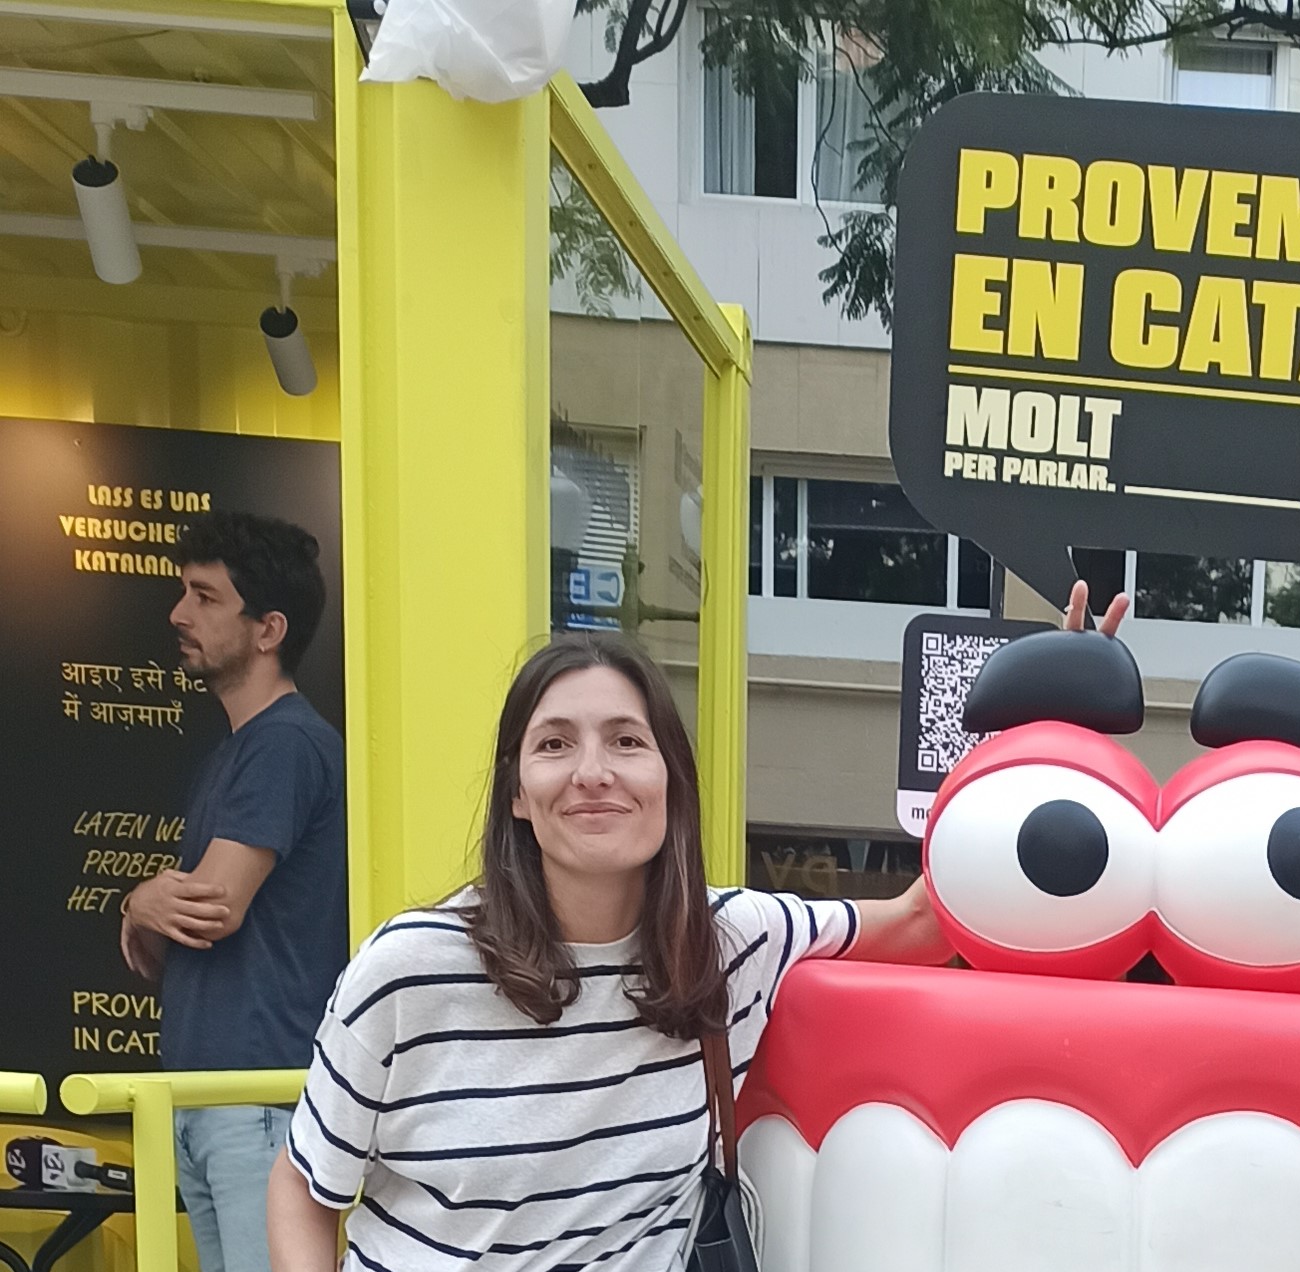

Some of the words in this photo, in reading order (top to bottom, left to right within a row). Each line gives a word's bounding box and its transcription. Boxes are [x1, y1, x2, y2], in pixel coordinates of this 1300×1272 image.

[949, 253, 1084, 361] EN
[945, 384, 1122, 459] MOLT
[944, 451, 996, 481] PER
[1003, 456, 1116, 492] PARLAR.
[88, 484, 133, 508] LASS
[140, 489, 162, 510] ES
[170, 490, 211, 512] UNS
[59, 515, 182, 544] VERSUCHE
[62, 662, 123, 693] आइए
[129, 660, 166, 692] इसे
[62, 691, 82, 721] में
[73, 811, 151, 839] LATEN
[82, 850, 183, 877] PROBER
[67, 885, 121, 913] HET
[74, 1027, 100, 1051] IN
[107, 1029, 162, 1056] CAT
